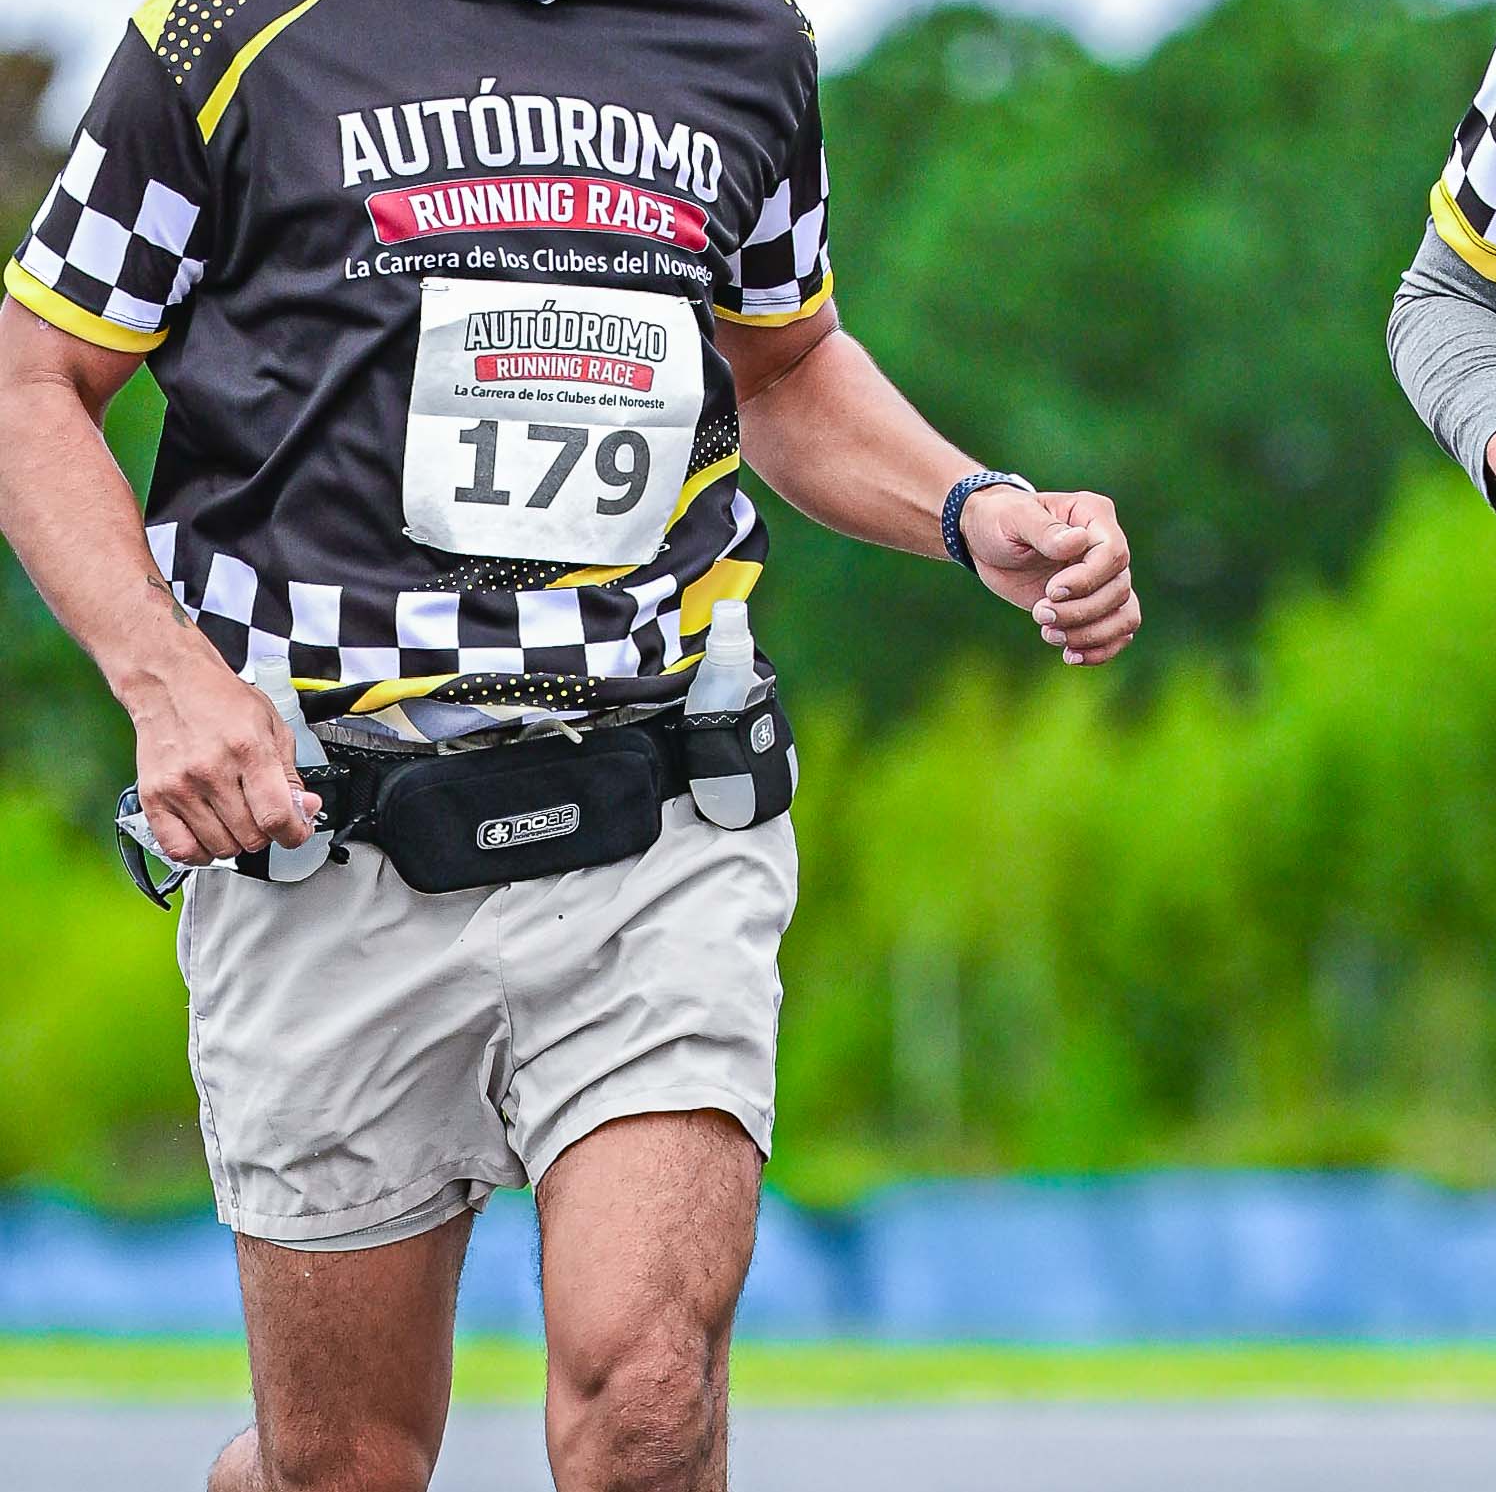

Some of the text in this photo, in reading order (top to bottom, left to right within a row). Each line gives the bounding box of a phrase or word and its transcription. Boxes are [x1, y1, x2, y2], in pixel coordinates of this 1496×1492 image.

[337, 76, 723, 204] AUTÓDROMO
[409, 178, 677, 240] RUNNING RACE
[345, 257, 370, 280] La
[375, 251, 460, 275] Carrera
[466, 245, 497, 269] de
[498, 246, 530, 270] los
[532, 248, 608, 273] Clubes
[613, 250, 649, 274] del
[464, 299, 667, 363] AUTÓDROMO
[454, 384, 665, 410] La Carrera de los Clubes del Noroeste
[496, 356, 636, 387] RUNNING RACE
[453, 419, 652, 517] 179
